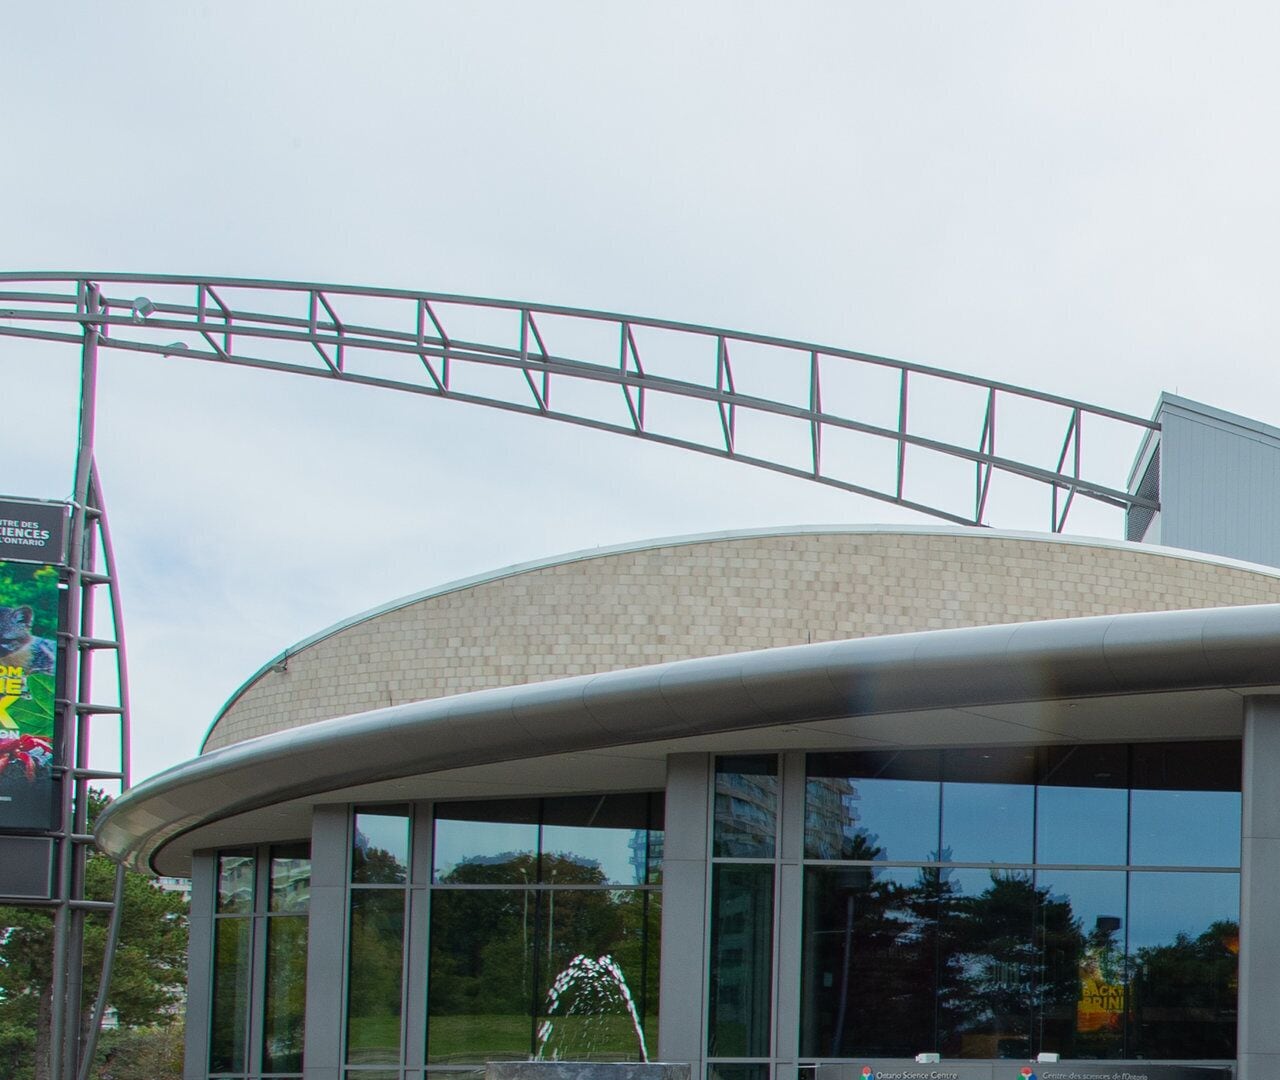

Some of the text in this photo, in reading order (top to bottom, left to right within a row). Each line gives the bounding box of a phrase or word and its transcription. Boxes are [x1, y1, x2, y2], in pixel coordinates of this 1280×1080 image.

[21, 521, 39, 529] DES
[0, 527, 50, 540] IENCES
[876, 1071, 958, 1080] Ontario Science Centre
[1042, 1071, 1066, 1080] Centre
[1068, 1071, 1081, 1080] des
[1082, 1072, 1110, 1080] sciences
